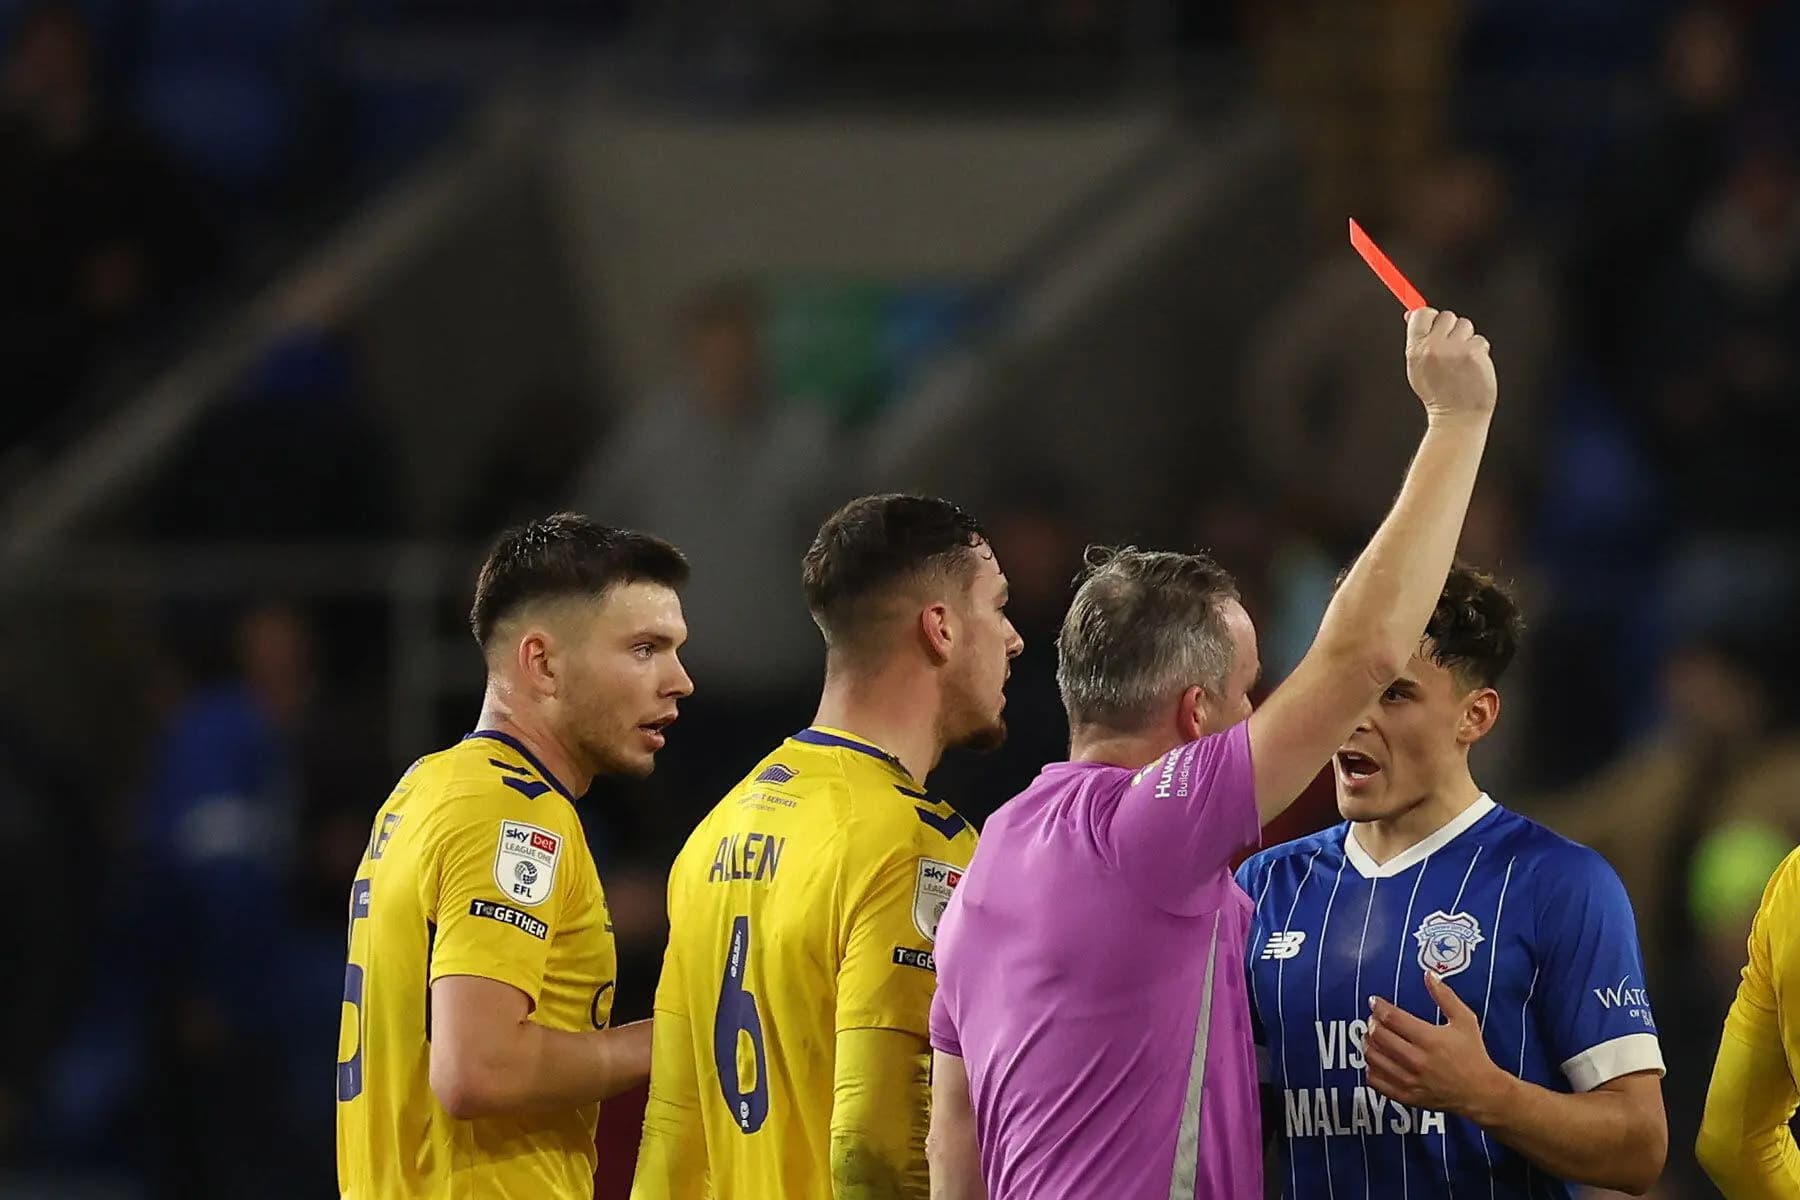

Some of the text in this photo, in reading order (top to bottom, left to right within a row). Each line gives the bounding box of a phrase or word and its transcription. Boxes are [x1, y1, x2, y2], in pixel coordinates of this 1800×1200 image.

[505, 828, 554, 851] sky bet
[505, 843, 537, 857] LEAGUE
[707, 833, 787, 883] ALLEN
[924, 867, 946, 882] sky
[513, 883, 532, 899] EFL
[1593, 975, 1650, 1009] WATC
[714, 915, 770, 1134] 6
[1315, 1019, 1369, 1070] VIS
[1284, 1086, 1446, 1138] MALAYSIA
